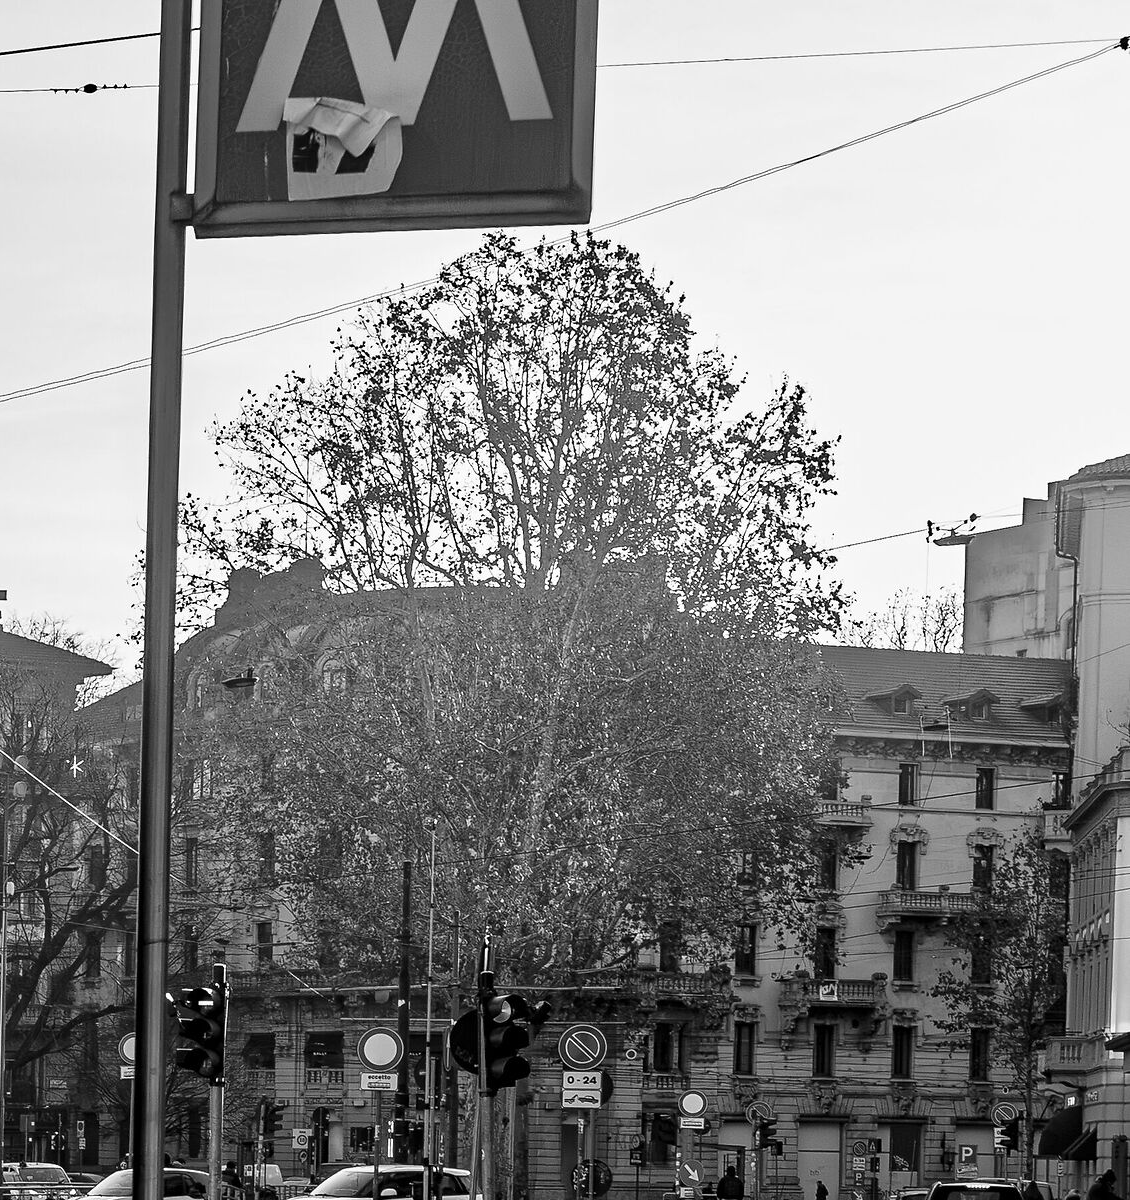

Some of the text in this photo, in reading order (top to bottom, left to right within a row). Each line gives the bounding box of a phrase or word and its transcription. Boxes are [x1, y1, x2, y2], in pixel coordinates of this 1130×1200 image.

[236, 0, 554, 132] M
[583, 1076, 597, 1084] 24
[962, 1147, 973, 1162] P
